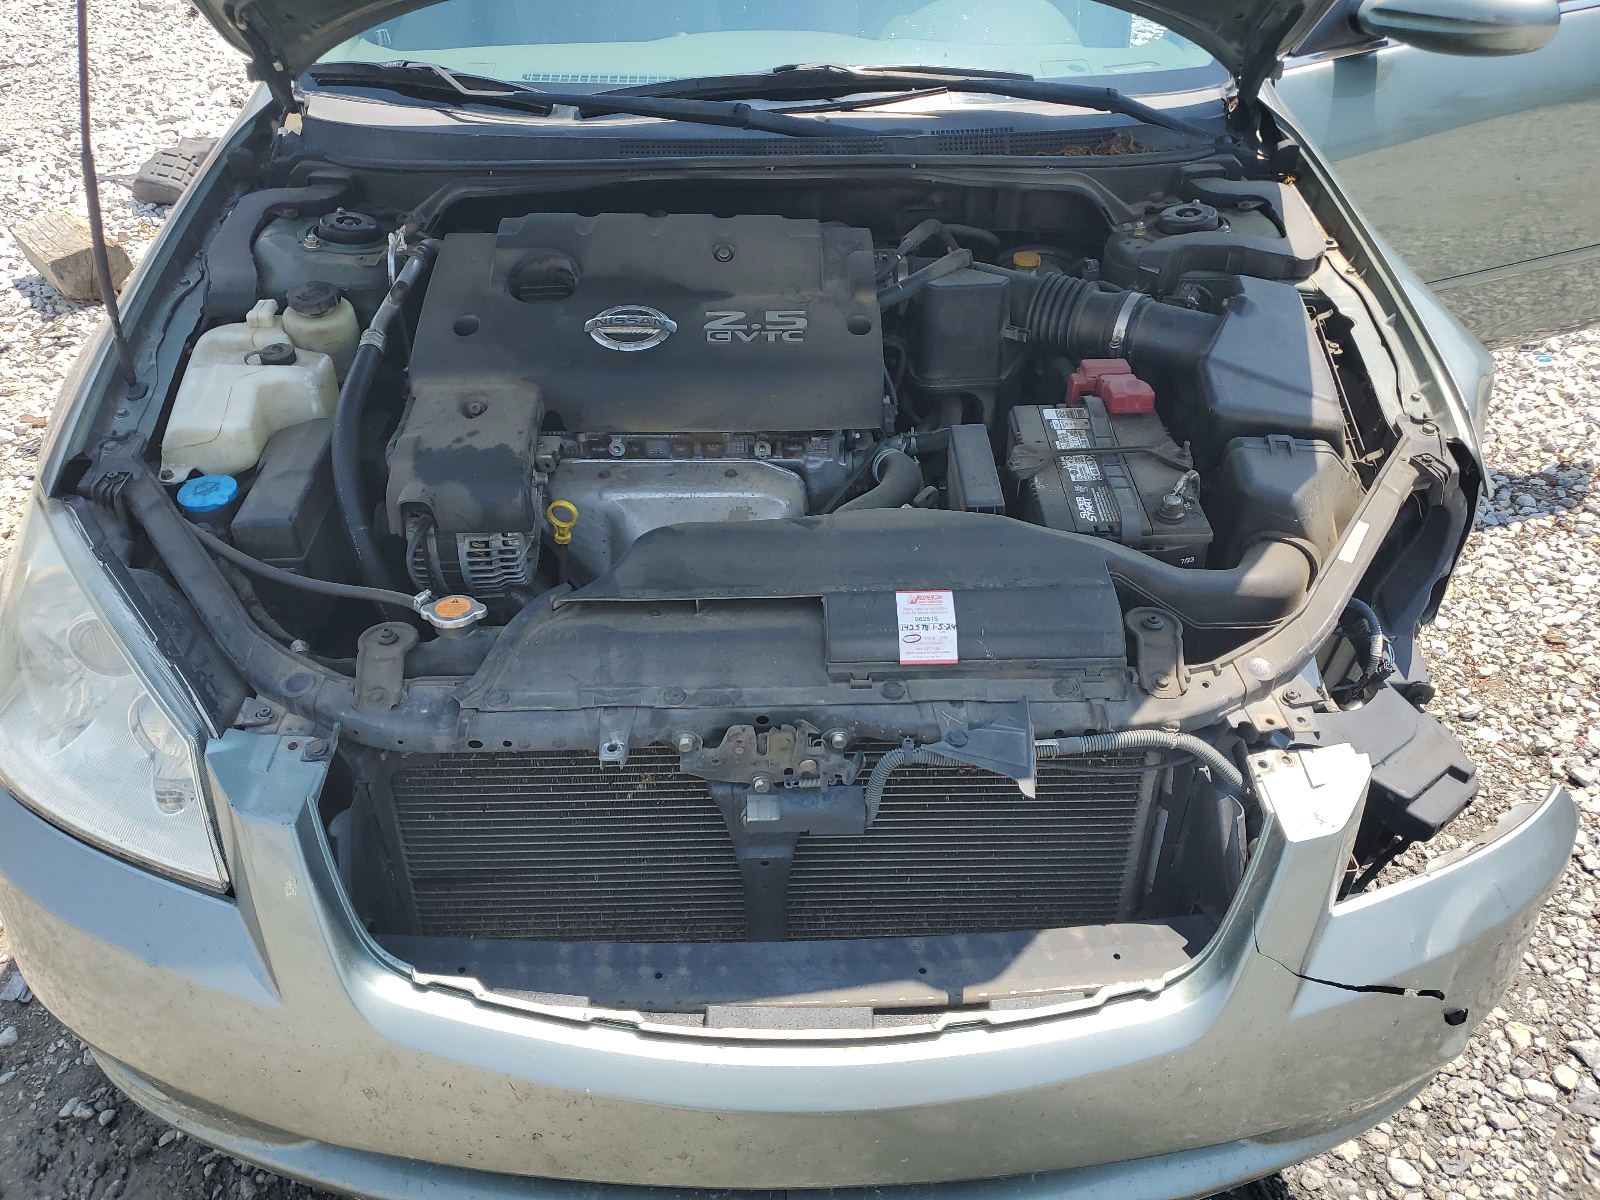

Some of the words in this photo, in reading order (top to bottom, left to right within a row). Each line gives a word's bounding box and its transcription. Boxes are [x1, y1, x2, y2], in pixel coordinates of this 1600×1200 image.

[594, 315, 667, 327] NISSAN
[703, 310, 808, 330] 2.5
[1075, 496, 1088, 519] SUPER
[1083, 497, 1098, 522] START
[1181, 556, 1195, 565] 7/23
